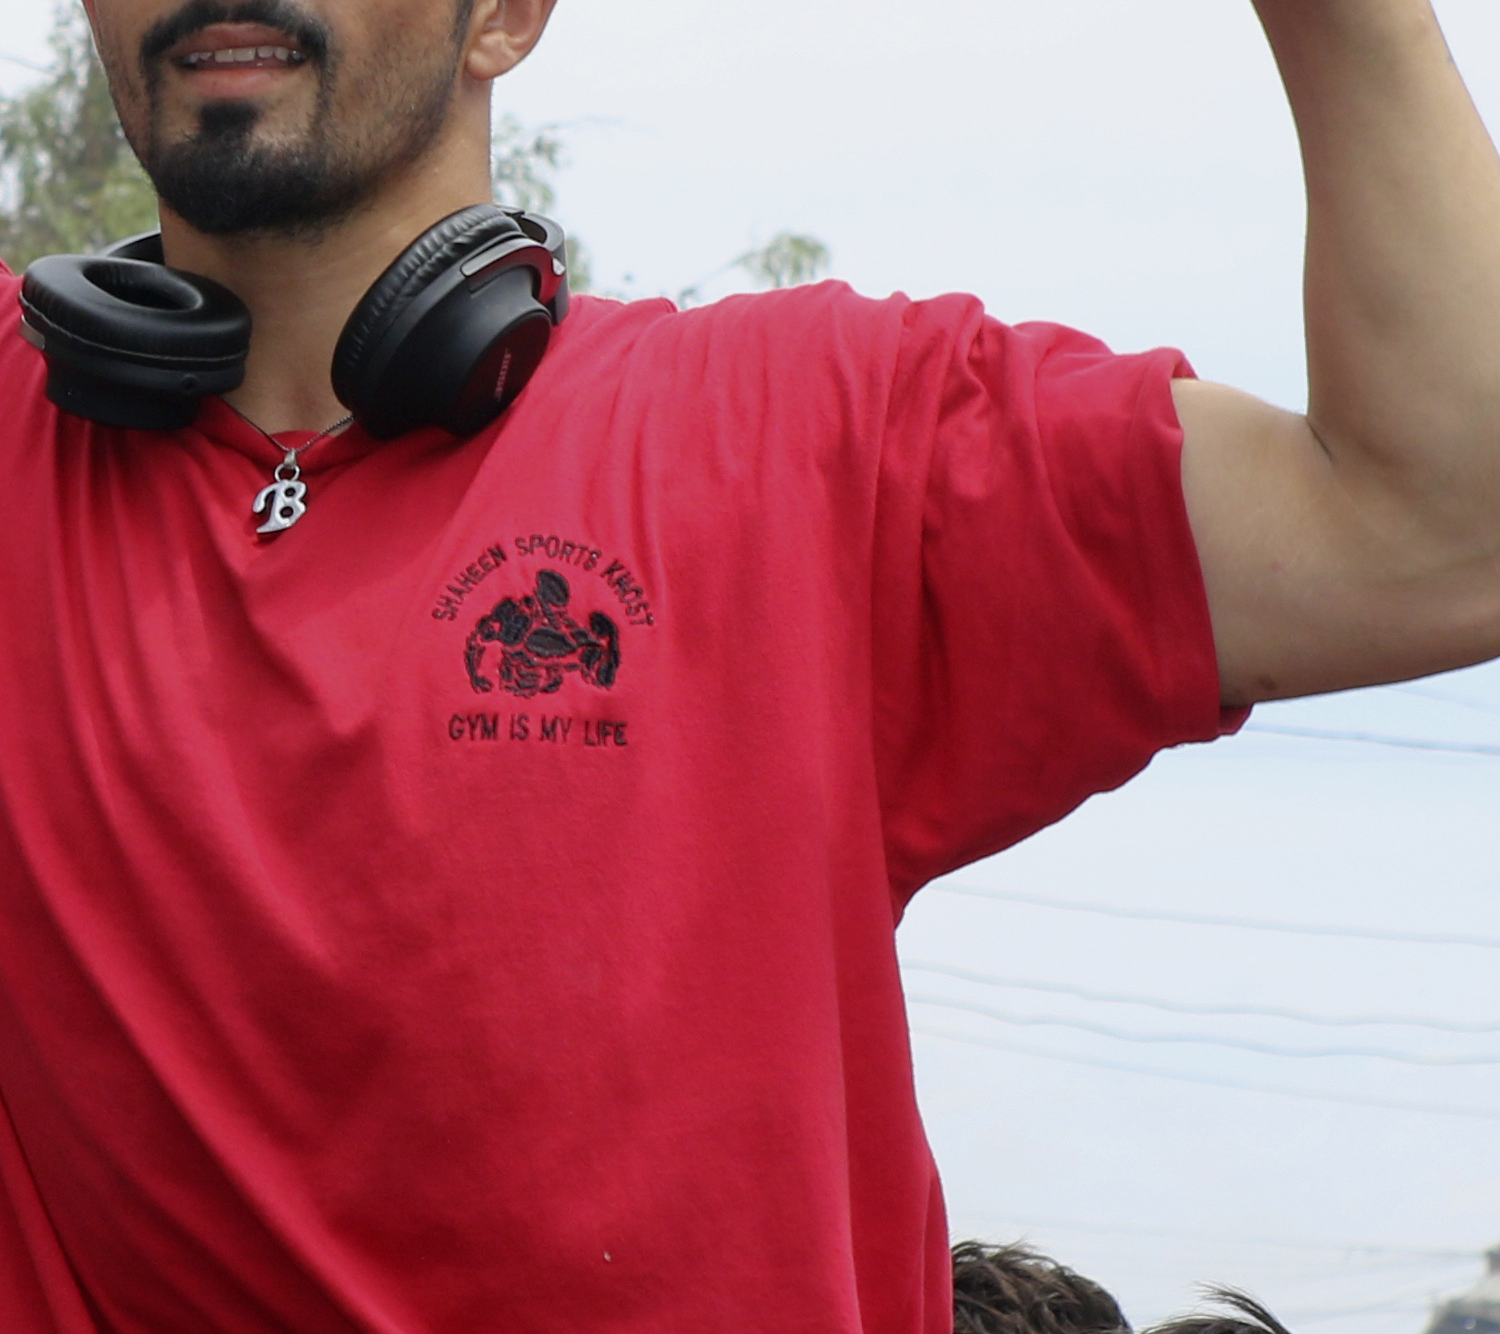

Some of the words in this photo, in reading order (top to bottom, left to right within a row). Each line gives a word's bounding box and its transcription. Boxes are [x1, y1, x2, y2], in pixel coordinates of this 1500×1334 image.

[432, 541, 509, 621] SHAHEEN
[515, 534, 602, 571] SPORTS
[601, 558, 655, 627] KHOST
[449, 713, 499, 742] GYM
[509, 713, 530, 741] IS
[539, 716, 573, 743] MY
[584, 720, 629, 748] LIFE
